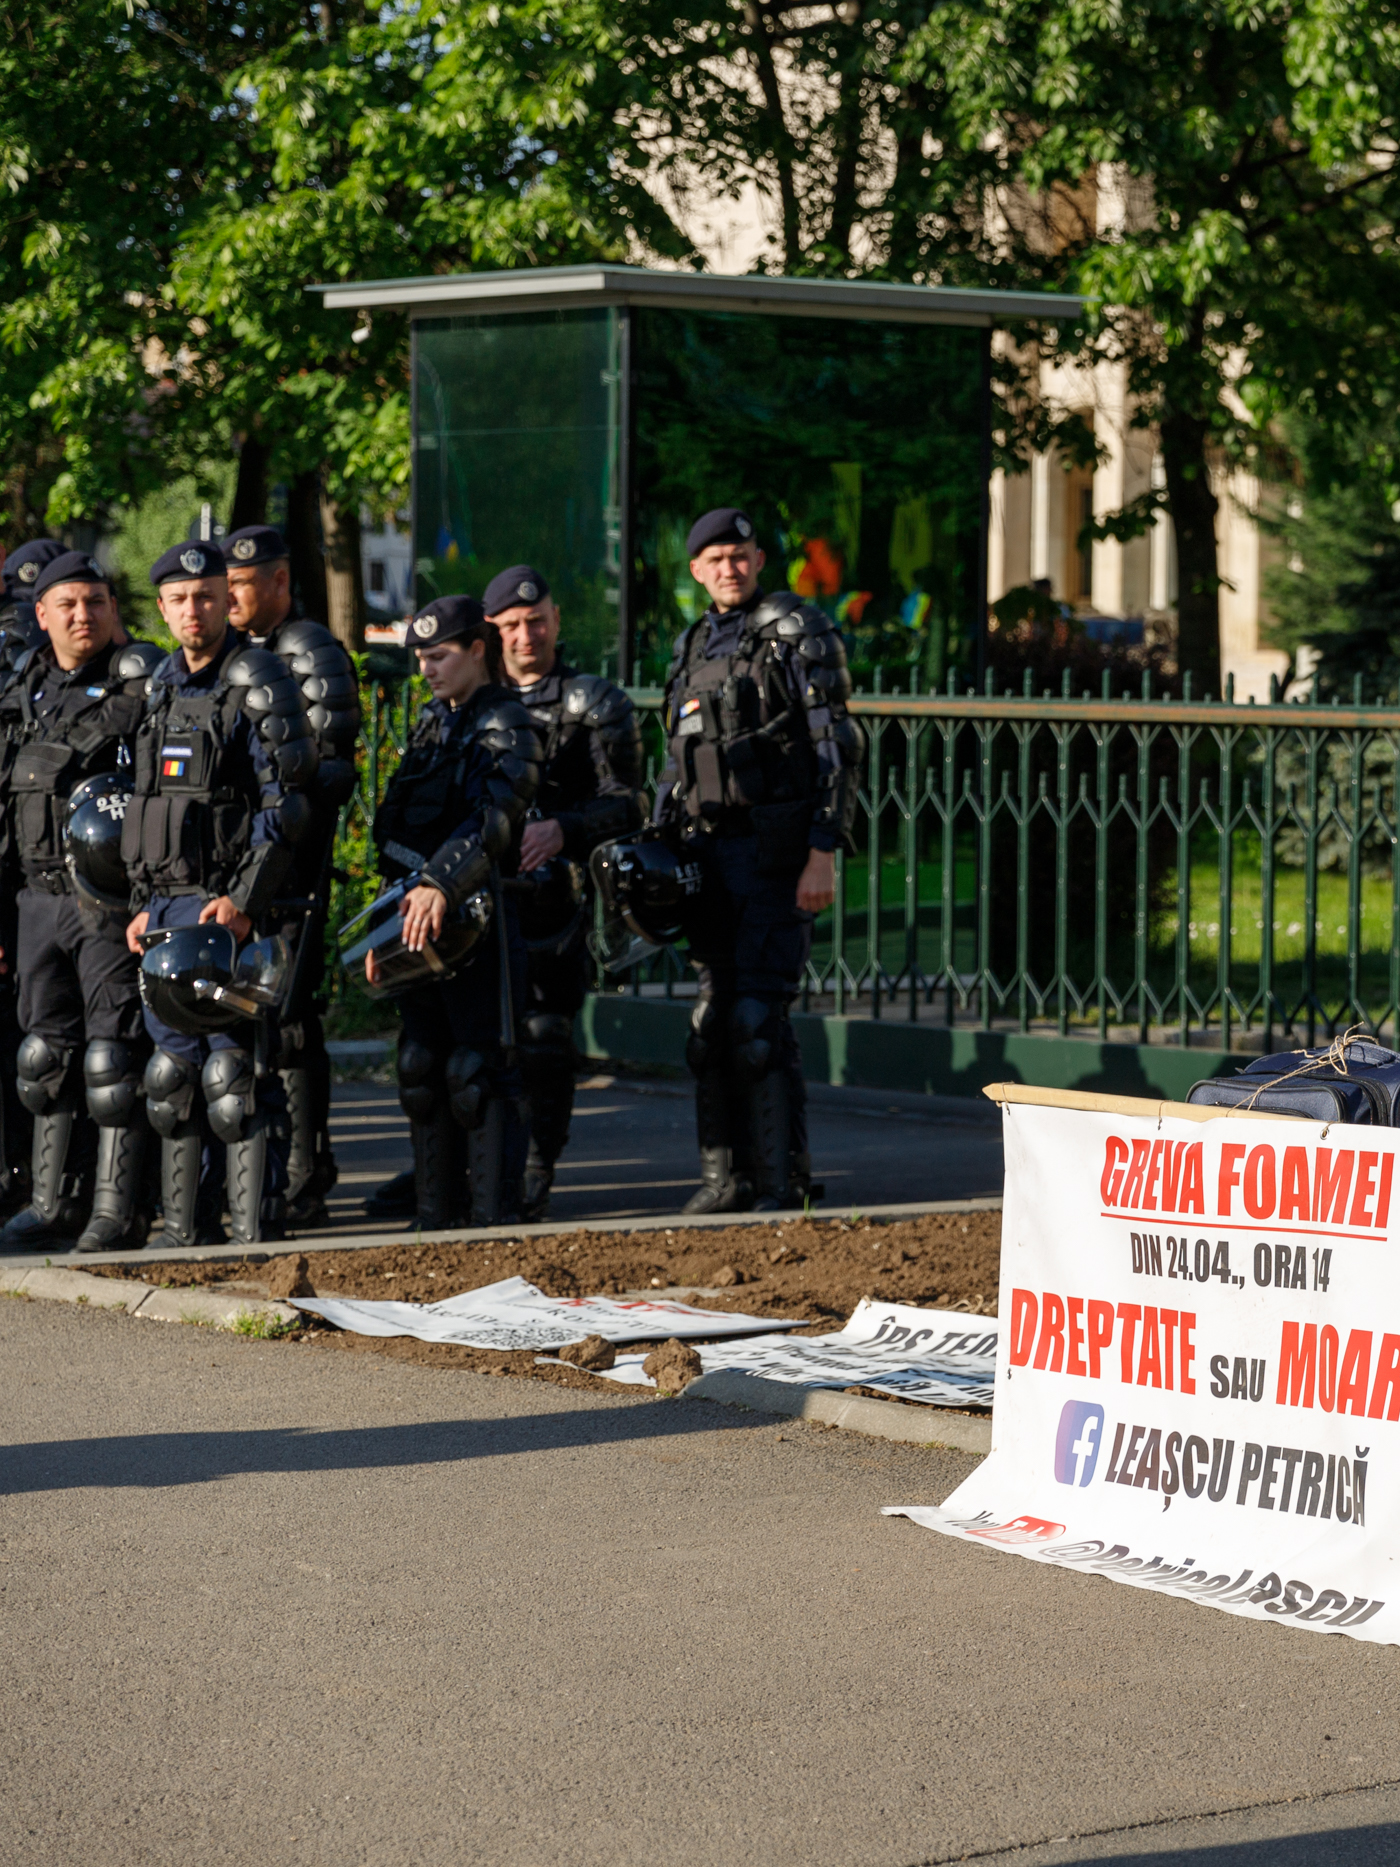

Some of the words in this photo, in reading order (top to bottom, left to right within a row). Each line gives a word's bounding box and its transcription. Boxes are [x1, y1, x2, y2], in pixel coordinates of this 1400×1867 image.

[1100, 1135, 1205, 1215] GREVA
[1217, 1143, 1395, 1229] FOAMEI
[1130, 1232, 1163, 1277] DIN
[1166, 1235, 1245, 1290] 24.04.,
[1253, 1242, 1307, 1290] ORA
[1312, 1247, 1333, 1293] 14
[1009, 1288, 1197, 1395] DREPTATE
[1210, 1355, 1266, 1403] SAU
[1105, 1422, 1235, 1513] LEAȘCU
[1236, 1445, 1370, 1527] PETRICĂ
